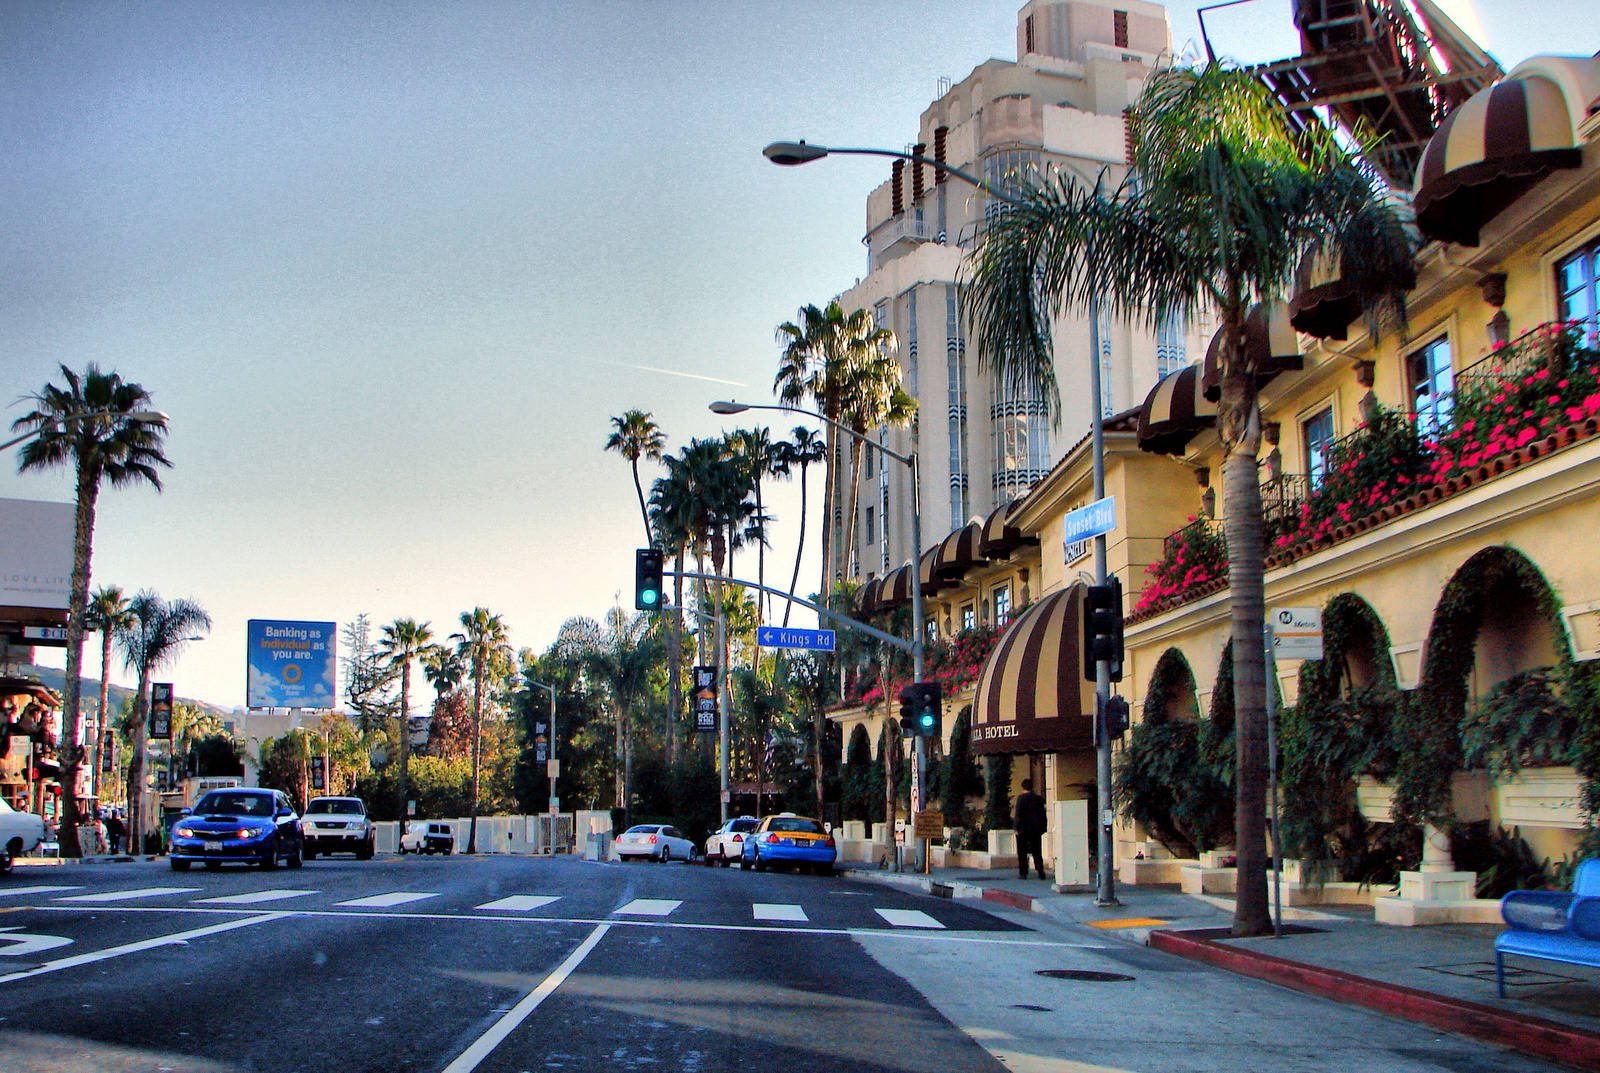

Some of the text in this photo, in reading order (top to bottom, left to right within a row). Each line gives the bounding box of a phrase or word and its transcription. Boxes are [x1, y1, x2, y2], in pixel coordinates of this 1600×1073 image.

[1067, 506, 1113, 537] Sunset Blvd
[265, 625, 321, 640] Banking as
[780, 632, 830, 647] Kings Rd
[261, 638, 325, 650] individual as
[272, 651, 313, 660] you are.
[985, 724, 1019, 739] HOTEL
